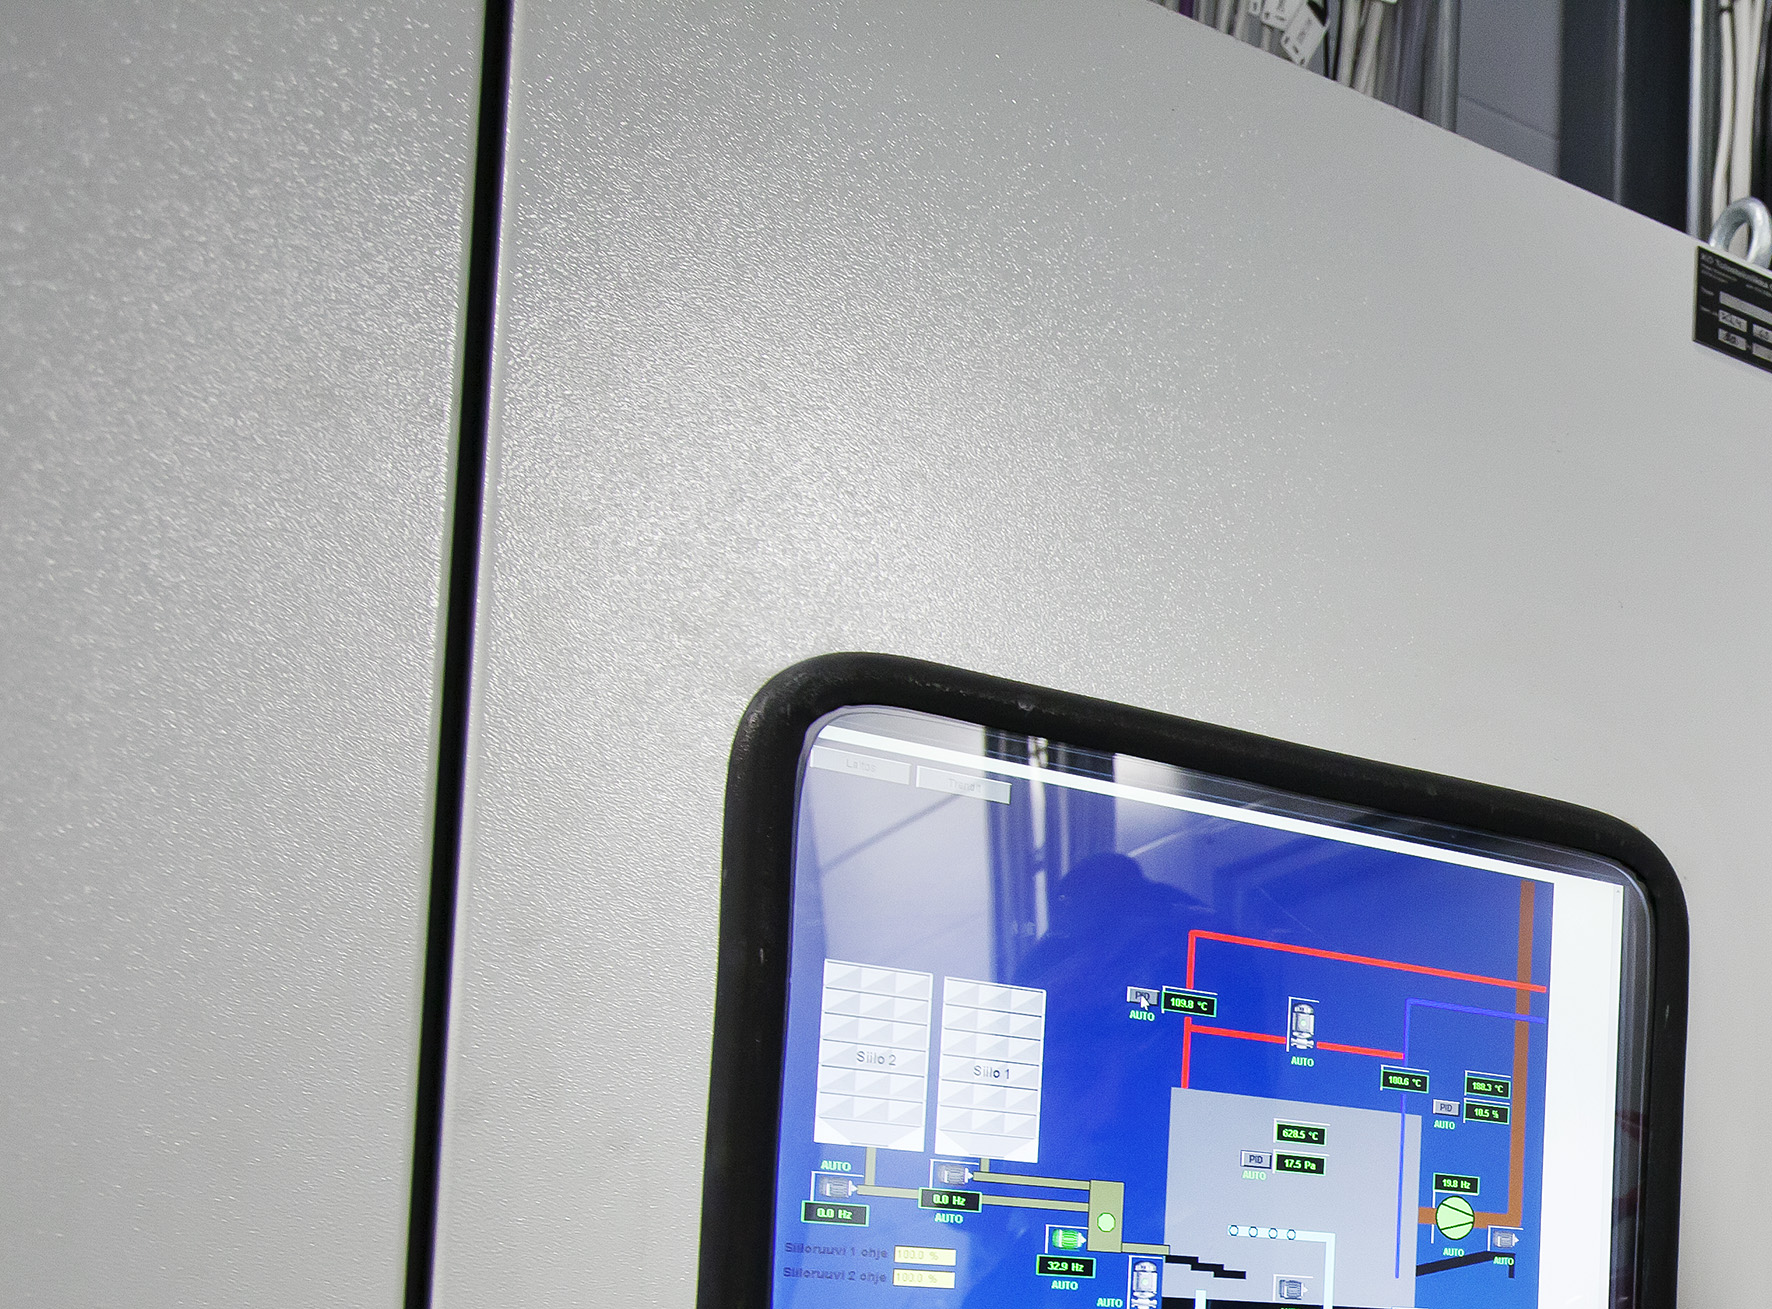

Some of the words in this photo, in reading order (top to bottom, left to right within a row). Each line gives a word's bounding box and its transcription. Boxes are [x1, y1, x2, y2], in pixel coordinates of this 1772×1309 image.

[1170, 998, 1194, 1009] 109.8
[1129, 1010, 1155, 1021] AUTO
[856, 1051, 884, 1064] Siilo
[889, 1055, 896, 1066] 2
[1291, 1056, 1314, 1067] AUTO
[974, 1065, 1000, 1078] Siilo
[1005, 1069, 1010, 1079] 1
[1440, 1103, 1452, 1112] PID
[1434, 1120, 1455, 1129] AUTO
[1282, 1129, 1305, 1139] 628.5
[1249, 1155, 1263, 1164] PID
[1284, 1159, 1301, 1168] 17.5
[1304, 1161, 1316, 1170] Pa
[821, 1160, 851, 1172] AUTO
[1242, 1170, 1266, 1180] AUTO
[1442, 1179, 1458, 1188] 19.8
[1461, 1180, 1471, 1189] Hz
[952, 1196, 966, 1206] Hz
[838, 1209, 852, 1220] Hz
[935, 1213, 963, 1224] AUTO
[861, 1247, 888, 1260] ohje
[1443, 1248, 1464, 1257] AUTO
[1493, 1256, 1514, 1265] AUTO
[1047, 1261, 1068, 1271] 32.9
[1071, 1262, 1084, 1272] Hz
[860, 1272, 886, 1284] ohje
[1051, 1281, 1078, 1290] AUTO
[1097, 1298, 1123, 1307] AUTO
